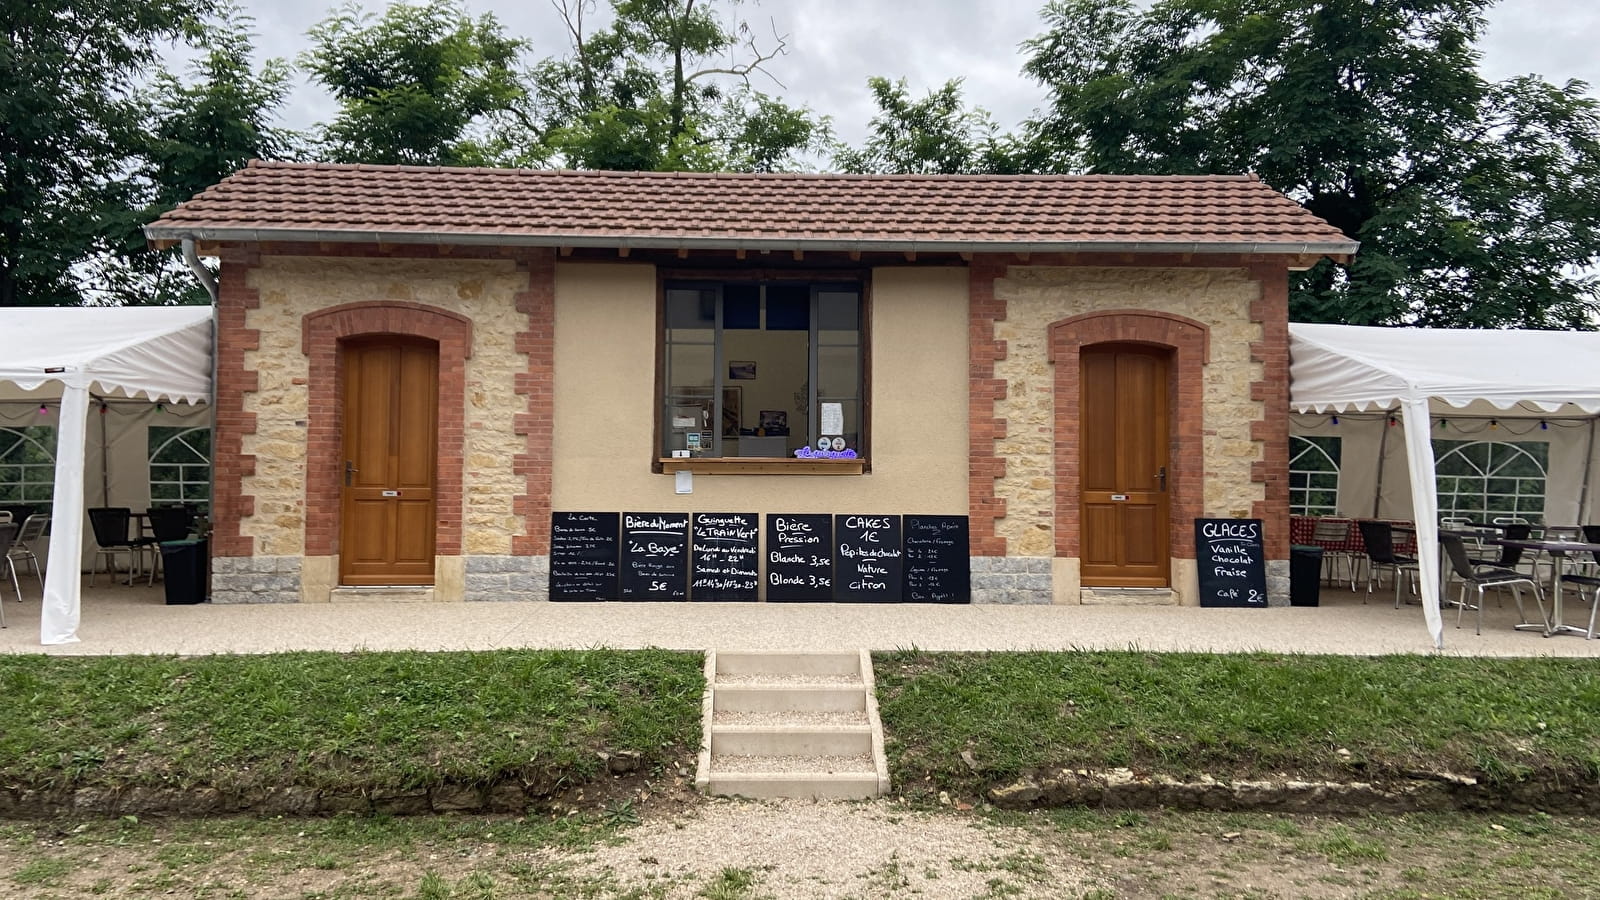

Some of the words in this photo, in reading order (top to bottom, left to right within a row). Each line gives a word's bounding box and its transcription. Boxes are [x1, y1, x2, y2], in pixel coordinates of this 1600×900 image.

[626, 515, 649, 528] Bière
[650, 519, 659, 528] du
[659, 516, 688, 530] Moment
[698, 514, 748, 526] Guinguette
[776, 518, 812, 531] Bière
[846, 516, 891, 528] CAKES
[860, 530, 880, 542] 1€
[1203, 523, 1258, 538] GLACES
[778, 533, 819, 543] Pression
[1211, 545, 1248, 555] Vanille
[770, 551, 806, 563] Blanche
[810, 555, 831, 567] 3,5€
[696, 565, 720, 573] Samedi
[857, 564, 888, 573] Nature
[1215, 566, 1247, 577] Fraise
[649, 581, 667, 590] 5€
[770, 572, 805, 585] Blonde
[809, 575, 831, 588] 3,5€
[1247, 589, 1265, 602] 2€
